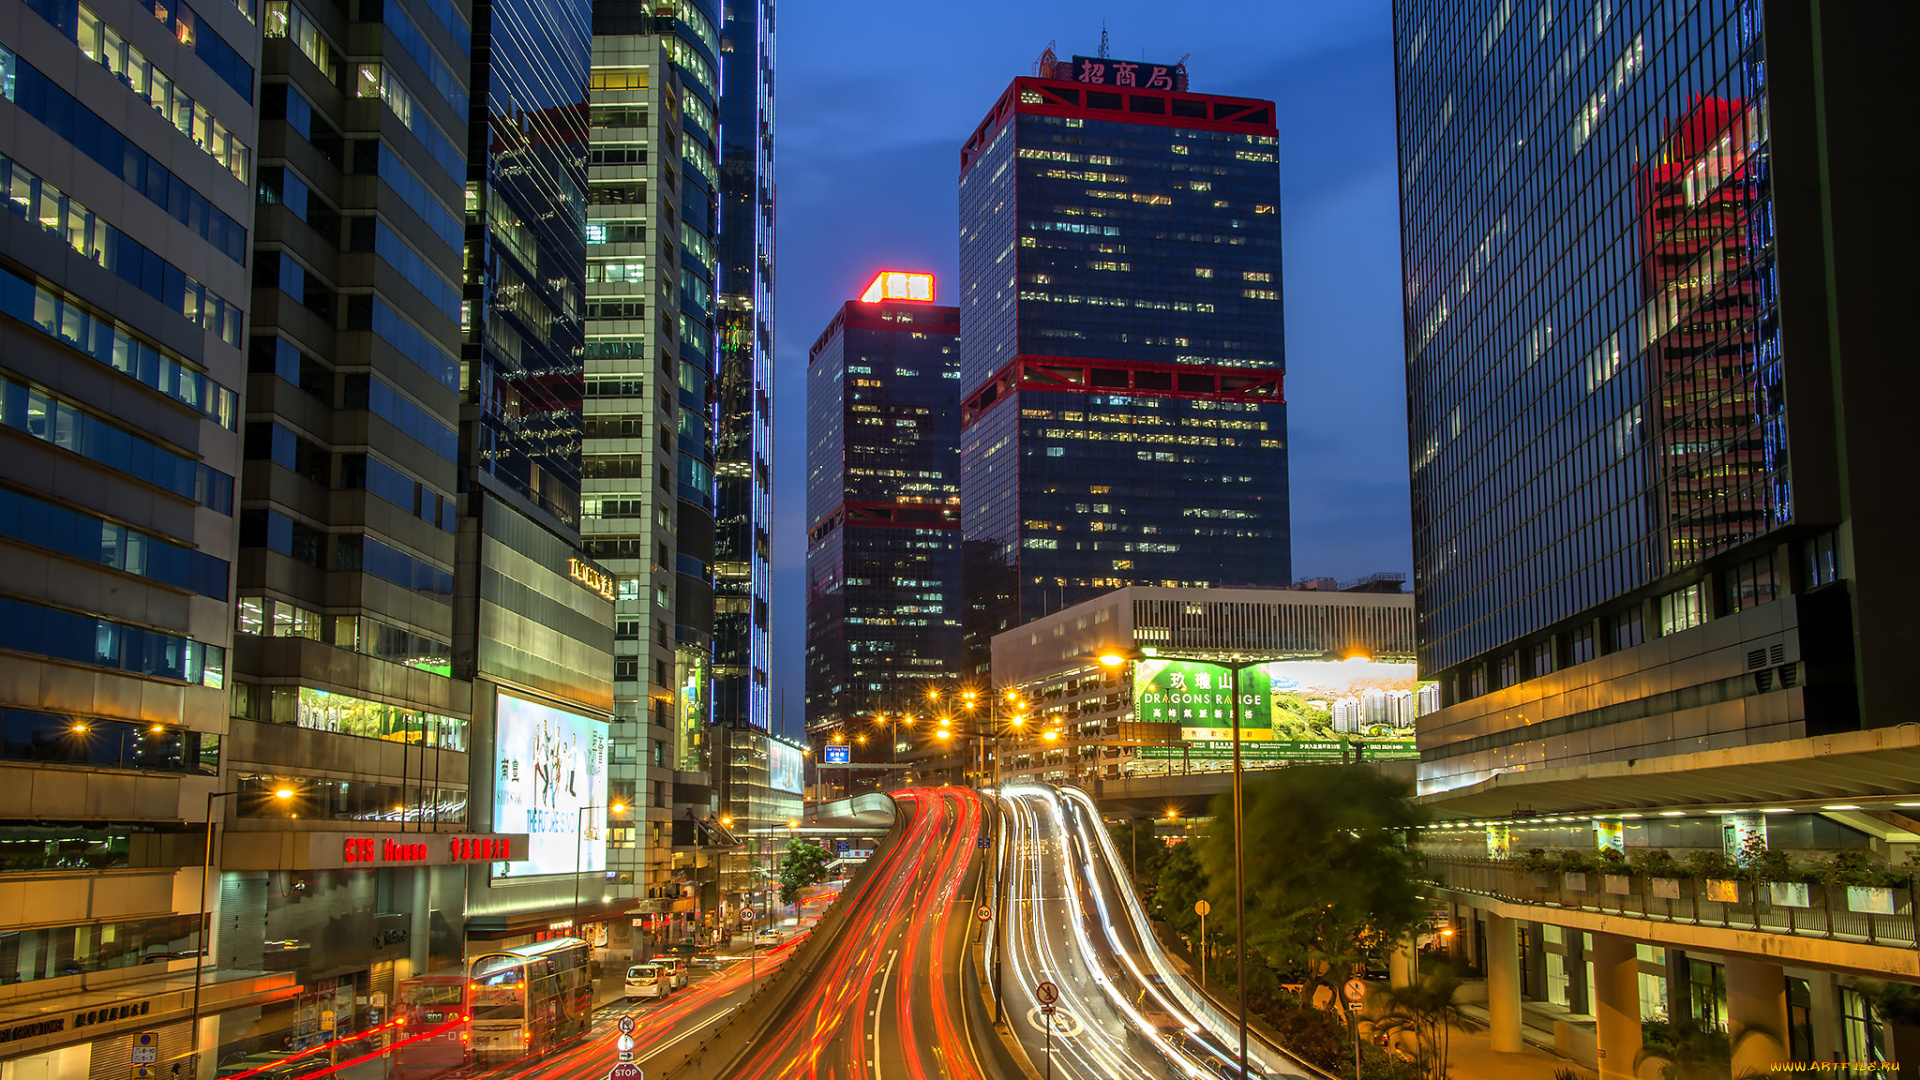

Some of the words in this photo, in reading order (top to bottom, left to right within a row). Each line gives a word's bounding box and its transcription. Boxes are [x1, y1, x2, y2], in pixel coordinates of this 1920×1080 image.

[1079, 59, 1173, 91] 招商局
[1170, 672, 1233, 690] 玖瓏山
[1144, 693, 1210, 704] DRAGONS
[345, 837, 375, 863] CTS
[384, 838, 428, 862] House
[741, 910, 752, 919] 80
[614, 1069, 637, 1077] STOP
